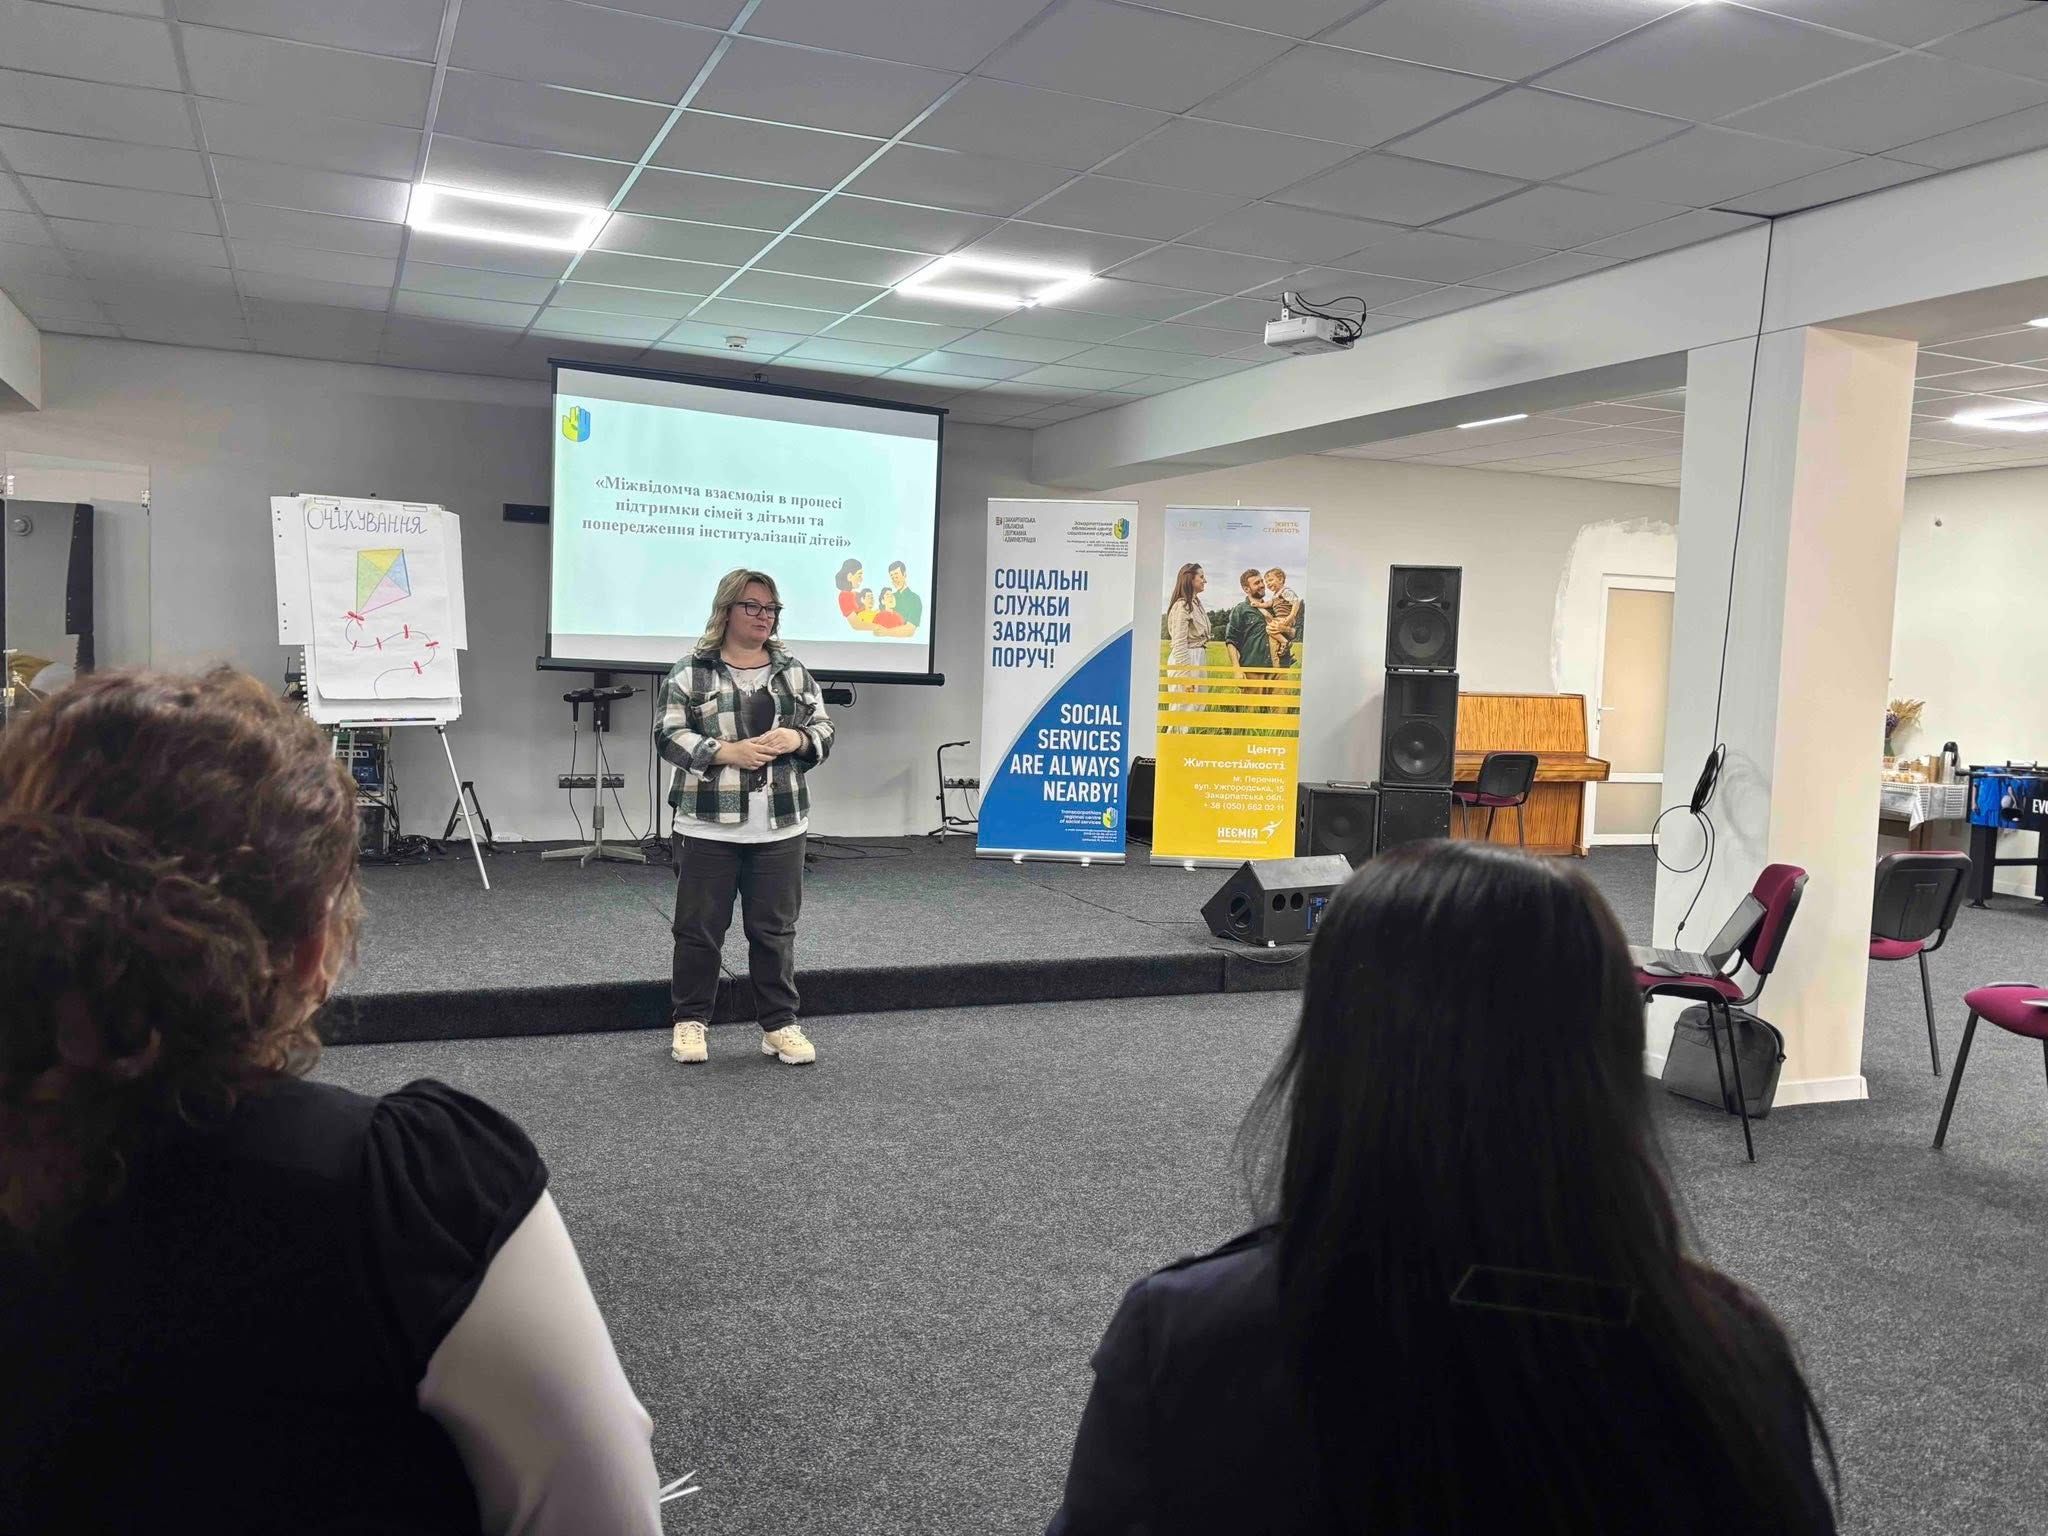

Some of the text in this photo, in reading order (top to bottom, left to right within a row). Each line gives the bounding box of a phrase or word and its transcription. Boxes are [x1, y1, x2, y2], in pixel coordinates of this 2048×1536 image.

[595, 475, 701, 497] «Міжвідомча
[704, 488, 774, 504] взаємодія
[778, 495, 787, 504] в
[306, 507, 428, 535] ОЧІКУВАННЯ
[615, 499, 824, 527] підтримки сімей з дітьми та
[582, 519, 852, 548] попередження інституалізації дітей»
[994, 568, 1089, 593] СОЦІАЛЬНІ
[993, 595, 1070, 617] СЛУЖБИ
[992, 621, 1071, 646] ЗАВЖДИ
[992, 647, 1055, 668] ПОРУЧ!
[1060, 703, 1122, 726] SOCIAL
[1038, 728, 1121, 752] SERVICES
[1247, 744, 1286, 756] Центр
[1010, 754, 1120, 778] ARE ALWAYS
[1043, 780, 1118, 803] NEARBY!
[1217, 827, 1258, 839] НЕЄМІЯ
